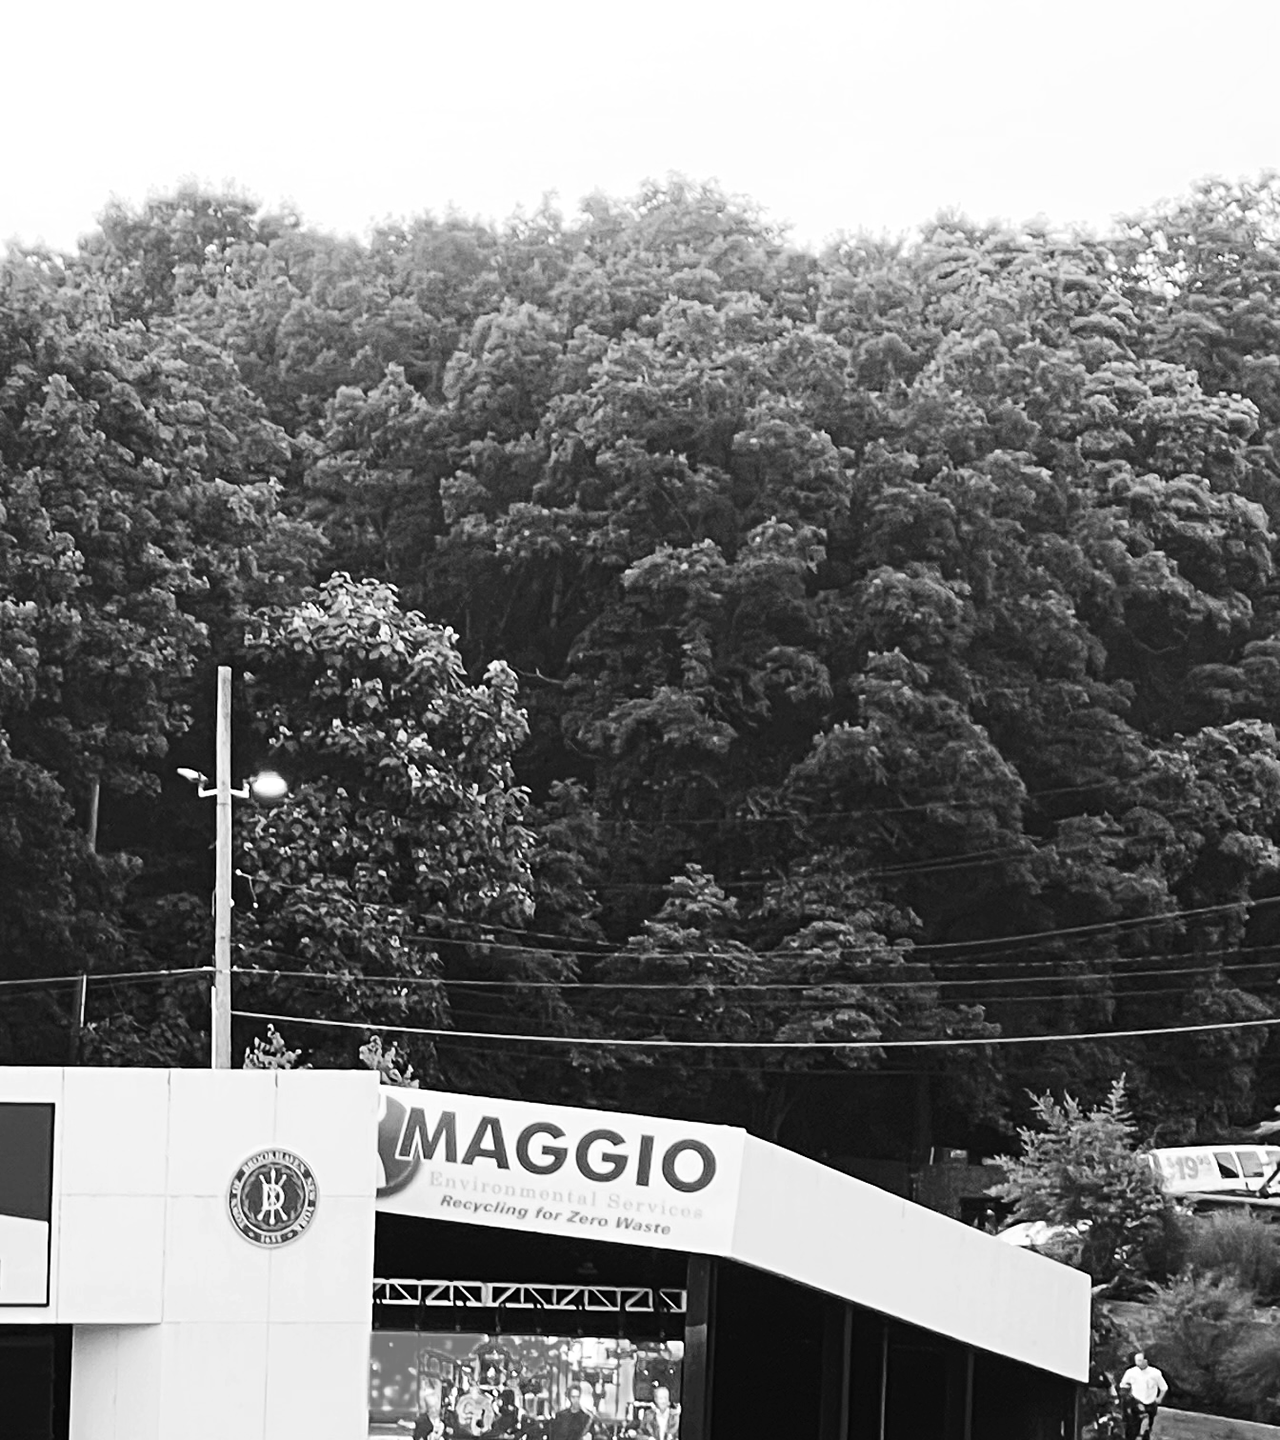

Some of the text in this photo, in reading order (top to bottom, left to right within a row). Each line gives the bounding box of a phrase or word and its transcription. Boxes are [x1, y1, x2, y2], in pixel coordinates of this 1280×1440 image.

[398, 1107, 716, 1193] MAGGIO
[429, 1171, 704, 1220] Environmental Services
[440, 1195, 671, 1236] Recycling for Zero Waste
